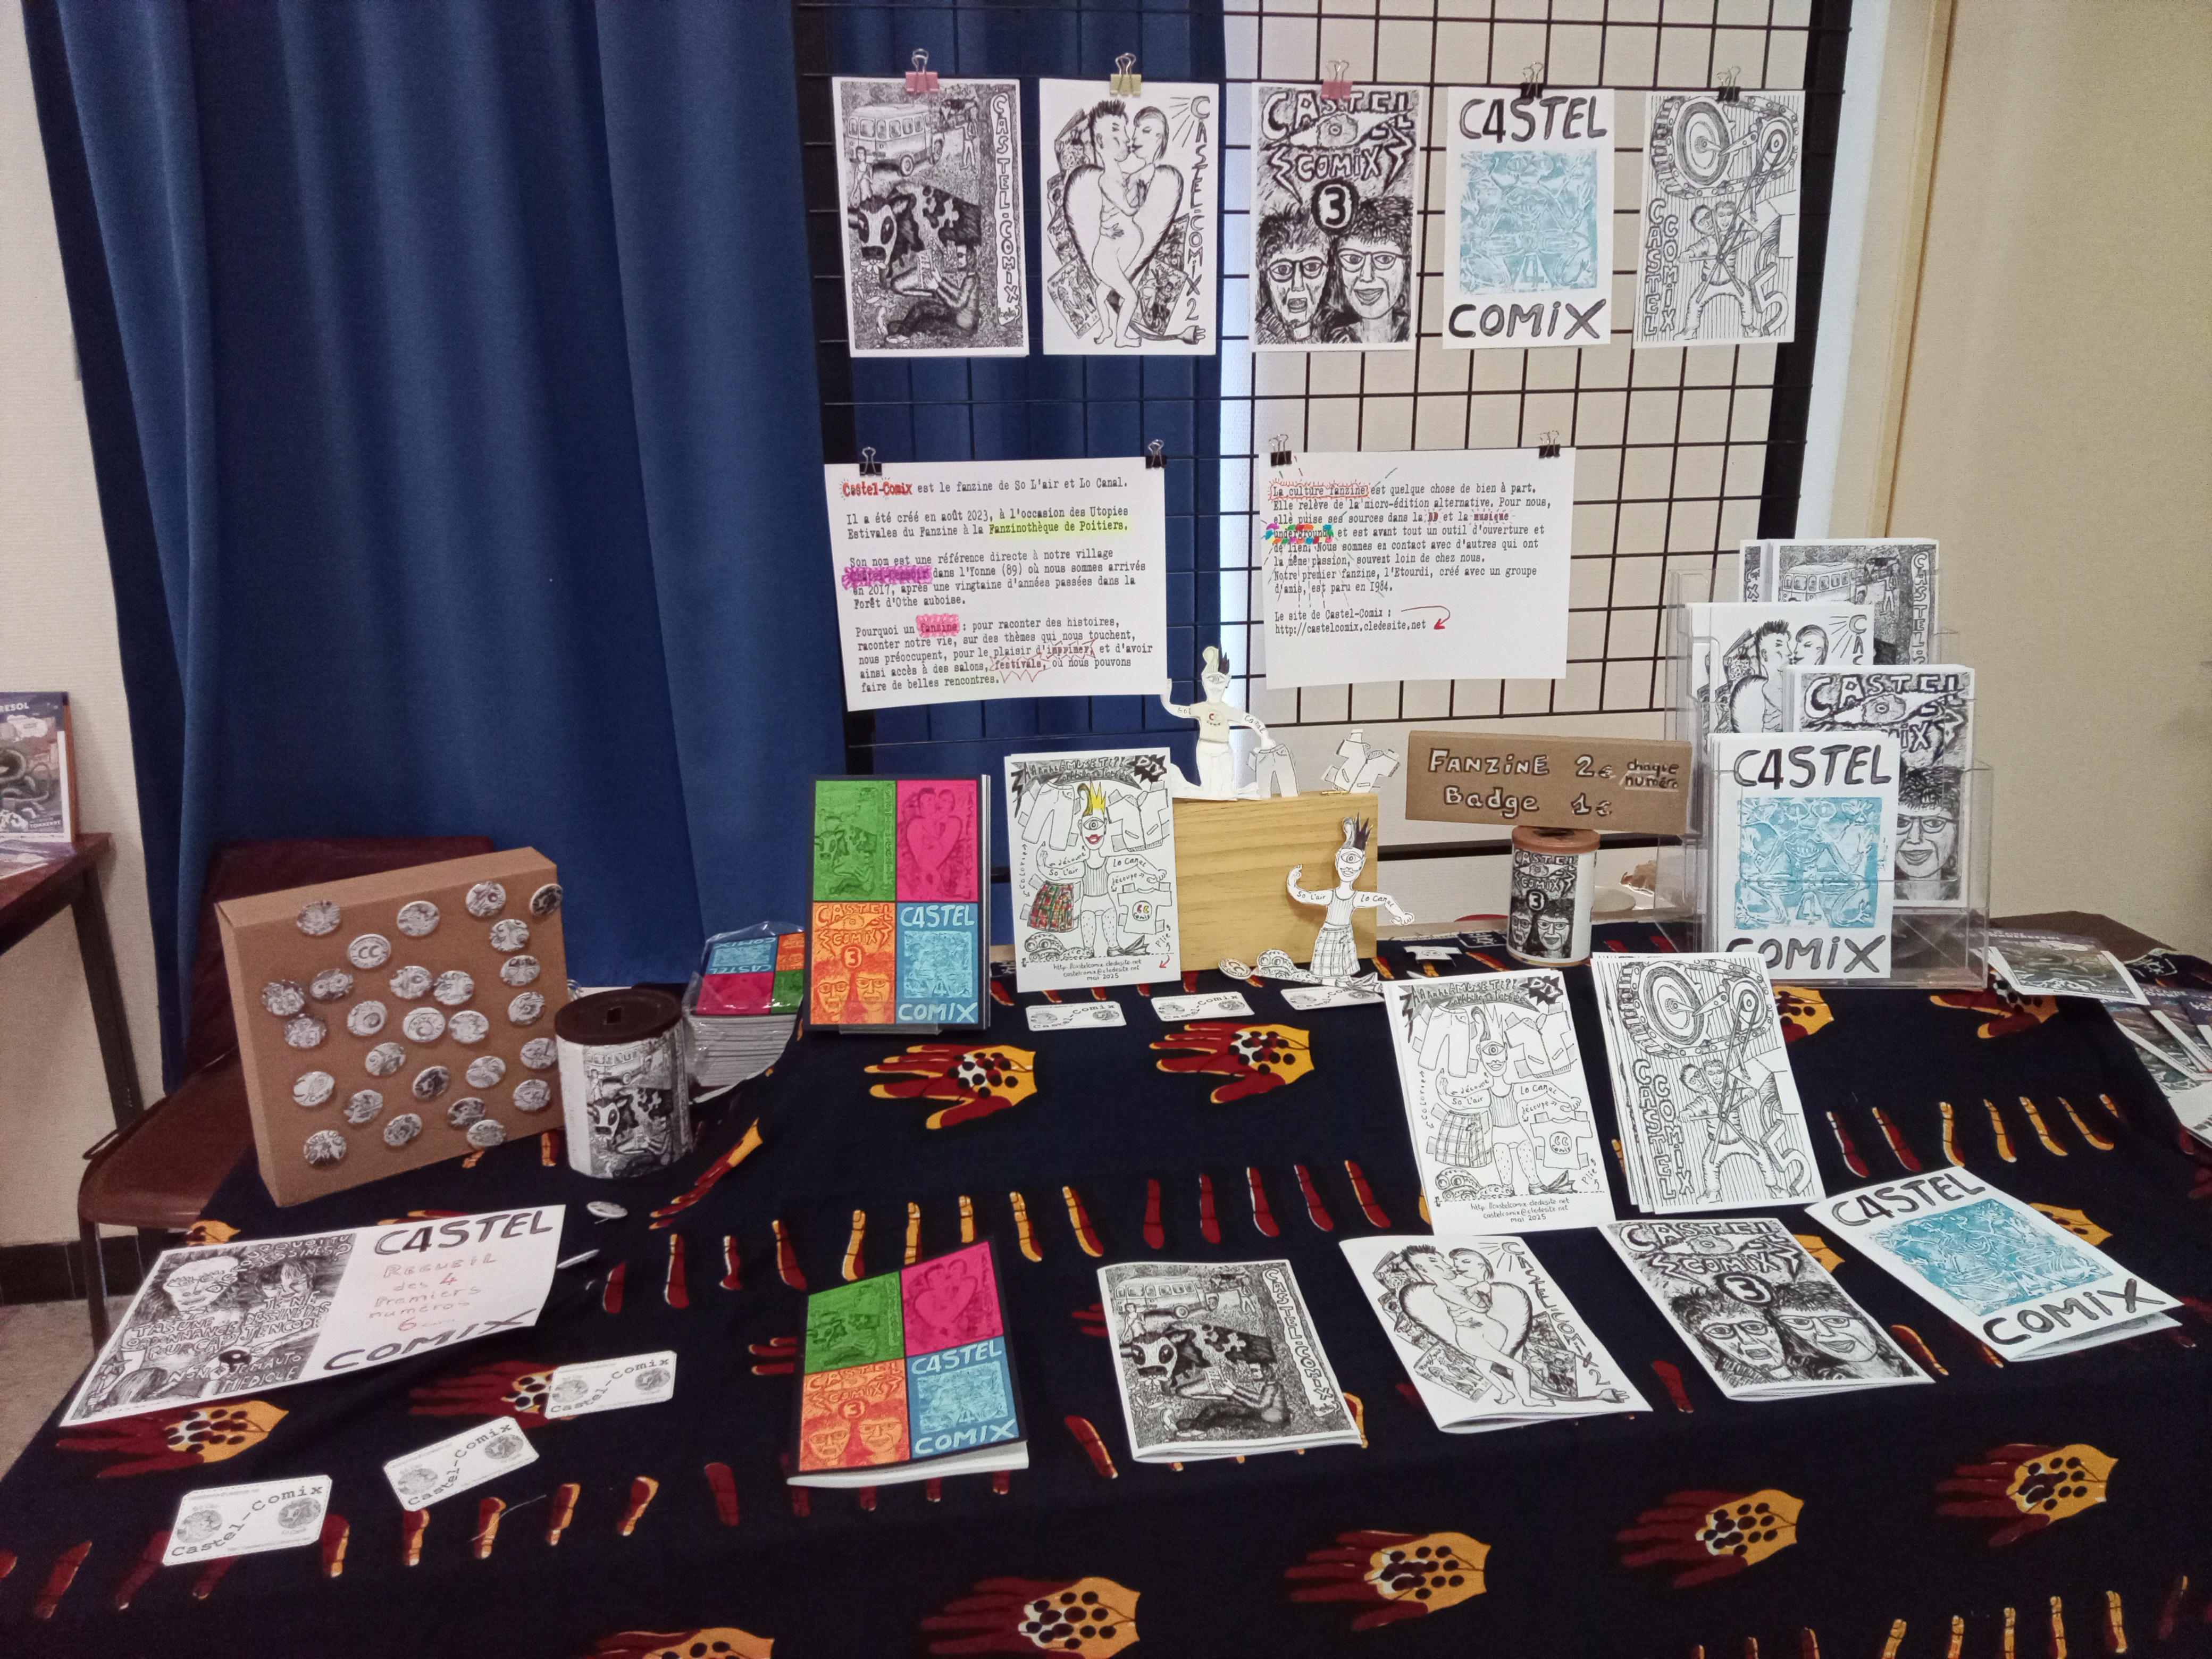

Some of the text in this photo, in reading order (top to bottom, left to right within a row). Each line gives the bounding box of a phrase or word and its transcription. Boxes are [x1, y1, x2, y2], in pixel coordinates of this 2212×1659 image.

[1261, 89, 1414, 140] CASTEL
[1324, 186, 1346, 226] 3
[1644, 197, 1666, 337] CASTEL
[1748, 262, 1789, 336] 5
[1186, 298, 1199, 321] 2
[842, 476, 1127, 495] Castel-Comix est le fanzine de So L'air et Lo Canal.
[1273, 497, 1550, 510] Elle relève de la micro-édition alternative. Pour nous,
[847, 513, 858, 524] Il
[875, 512, 891, 523] été
[897, 510, 918, 522] créé
[941, 509, 962, 521] août
[967, 509, 992, 522] 2023,
[999, 508, 1005, 519] à
[1010, 508, 1065, 519] l'occasion
[1069, 506, 1085, 517] des
[1090, 506, 1128, 518] Utopies
[847, 520, 1127, 538] Estivales du Fanzine à la Fanzinothèque de Poitiers.
[1337, 527, 1347, 537] et
[1353, 527, 1368, 537] est
[1372, 526, 1397, 537] avant
[1403, 526, 1421, 535] tout
[1442, 524, 1467, 535] outil
[1472, 524, 1528, 534] d'ouverture
[1534, 524, 1544, 534] et
[933, 567, 954, 577] dans
[960, 566, 995, 577] l'Yonne
[1002, 564, 1021, 576] (89)
[1028, 563, 1039, 575] où
[1071, 564, 1102, 572] sommes
[1108, 560, 1145, 571] arrivés
[853, 595, 965, 608] Forêt d'Othe auboise.
[1275, 608, 1382, 621] Le site de Castel-Comix
[973, 617, 1119, 632] pour raconter des histoires,
[1275, 621, 1426, 635] http://castelcomix.cledesite.net
[1804, 673, 1965, 719] CASTEL
[1627, 760, 1679, 775] chaque
[1624, 774, 1679, 788] numéro
[1444, 785, 1540, 819] Badge
[1058, 852, 1086, 866] découpe
[1125, 858, 1147, 867] Canal
[1514, 849, 1577, 871] CASTEL
[1112, 873, 1137, 885] découpe
[1372, 895, 1394, 908] Canal
[1531, 892, 1542, 909] 3
[816, 903, 894, 924] CASTEL
[1449, 981, 1488, 994] AMUSE
[1530, 978, 1560, 998] DIY
[1461, 1079, 1489, 1094] découpe
[1532, 1084, 1557, 1095] Canal
[1522, 1100, 1549, 1115] découpe
[1632, 1058, 1676, 1200] CASTEL
[1759, 1118, 1812, 1197] 5
[1619, 1222, 1790, 1253] CASTEL
[393, 1273, 457, 1292] des 4
[1727, 1277, 1766, 1301] 3
[398, 1317, 417, 1331] 6
[550, 1358, 669, 1413] Castel-Comix
[806, 1363, 903, 1391] CASTEL
[1588, 1369, 1611, 1386] 2
[407, 1424, 512, 1505] Castel-Comix
[171, 1486, 323, 1557] Castel-Comix
